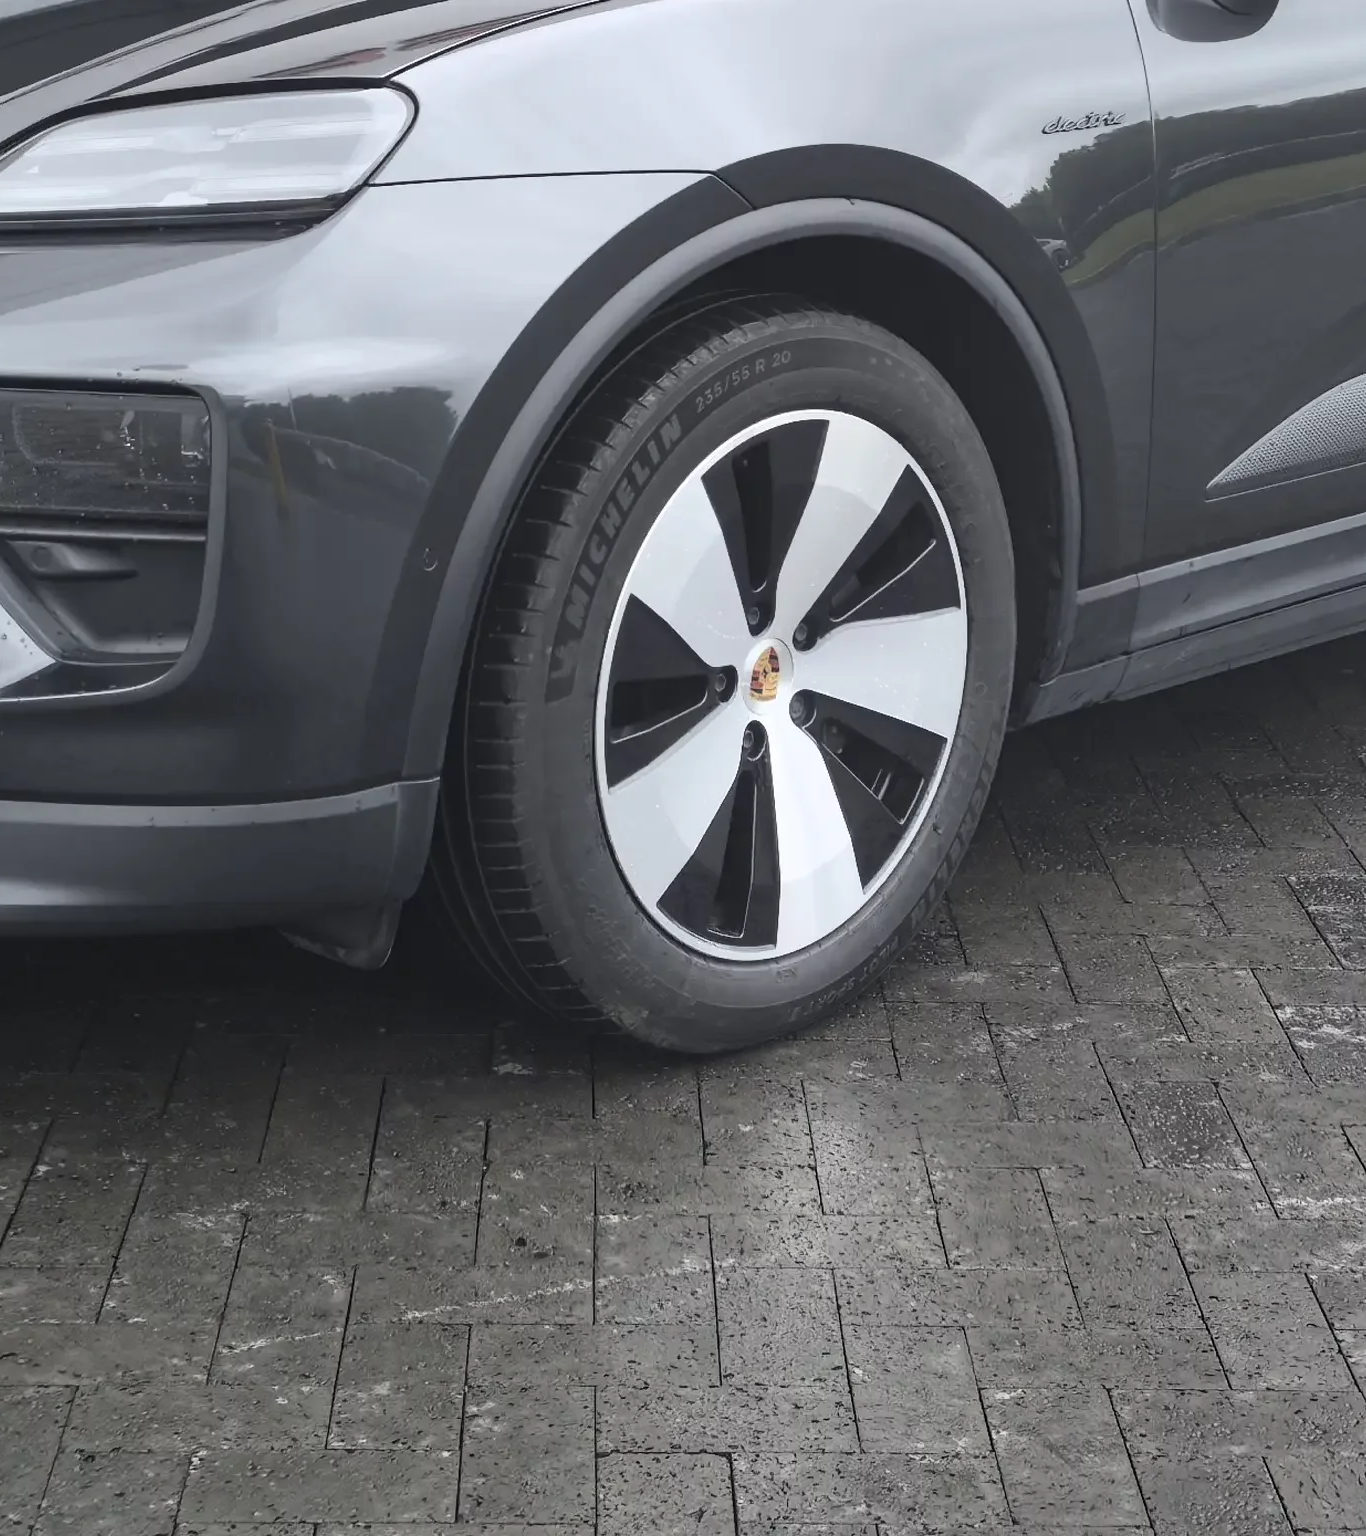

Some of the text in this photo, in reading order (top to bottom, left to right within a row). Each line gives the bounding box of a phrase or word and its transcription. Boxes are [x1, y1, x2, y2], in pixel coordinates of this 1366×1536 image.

[695, 350, 791, 413] 235/55 R 20
[564, 413, 683, 631] MICHELIN
